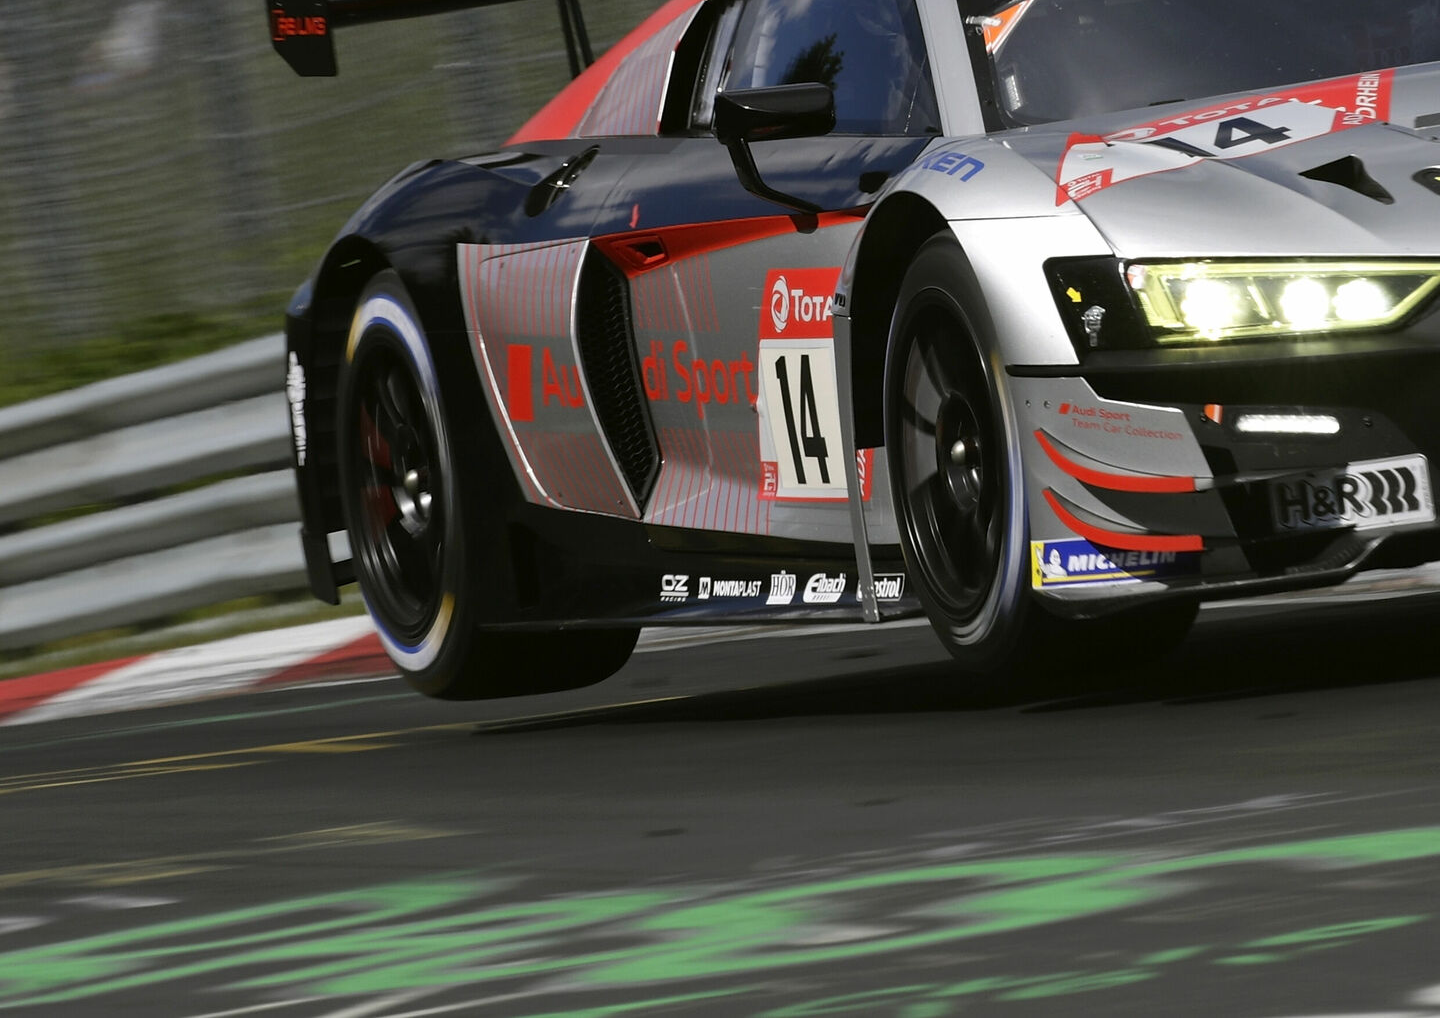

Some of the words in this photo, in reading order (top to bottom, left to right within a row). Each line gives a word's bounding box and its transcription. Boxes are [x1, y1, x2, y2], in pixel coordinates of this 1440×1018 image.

[1355, 73, 1381, 120] DRHEIN
[1143, 116, 1292, 158] 14
[791, 288, 835, 323] TOTA
[542, 339, 670, 409] Audi
[672, 339, 760, 420] Sport
[774, 354, 832, 485] 14
[1072, 405, 1097, 417] Audi
[1099, 408, 1131, 422] Sport
[1072, 417, 1101, 431] Team
[1103, 422, 1122, 434] Car
[1124, 424, 1184, 440] Collection
[1276, 476, 1369, 526] H&R
[1067, 551, 1177, 572] MICHELIN
[661, 574, 689, 592] OZ
[712, 580, 762, 598] MONTAPLAST
